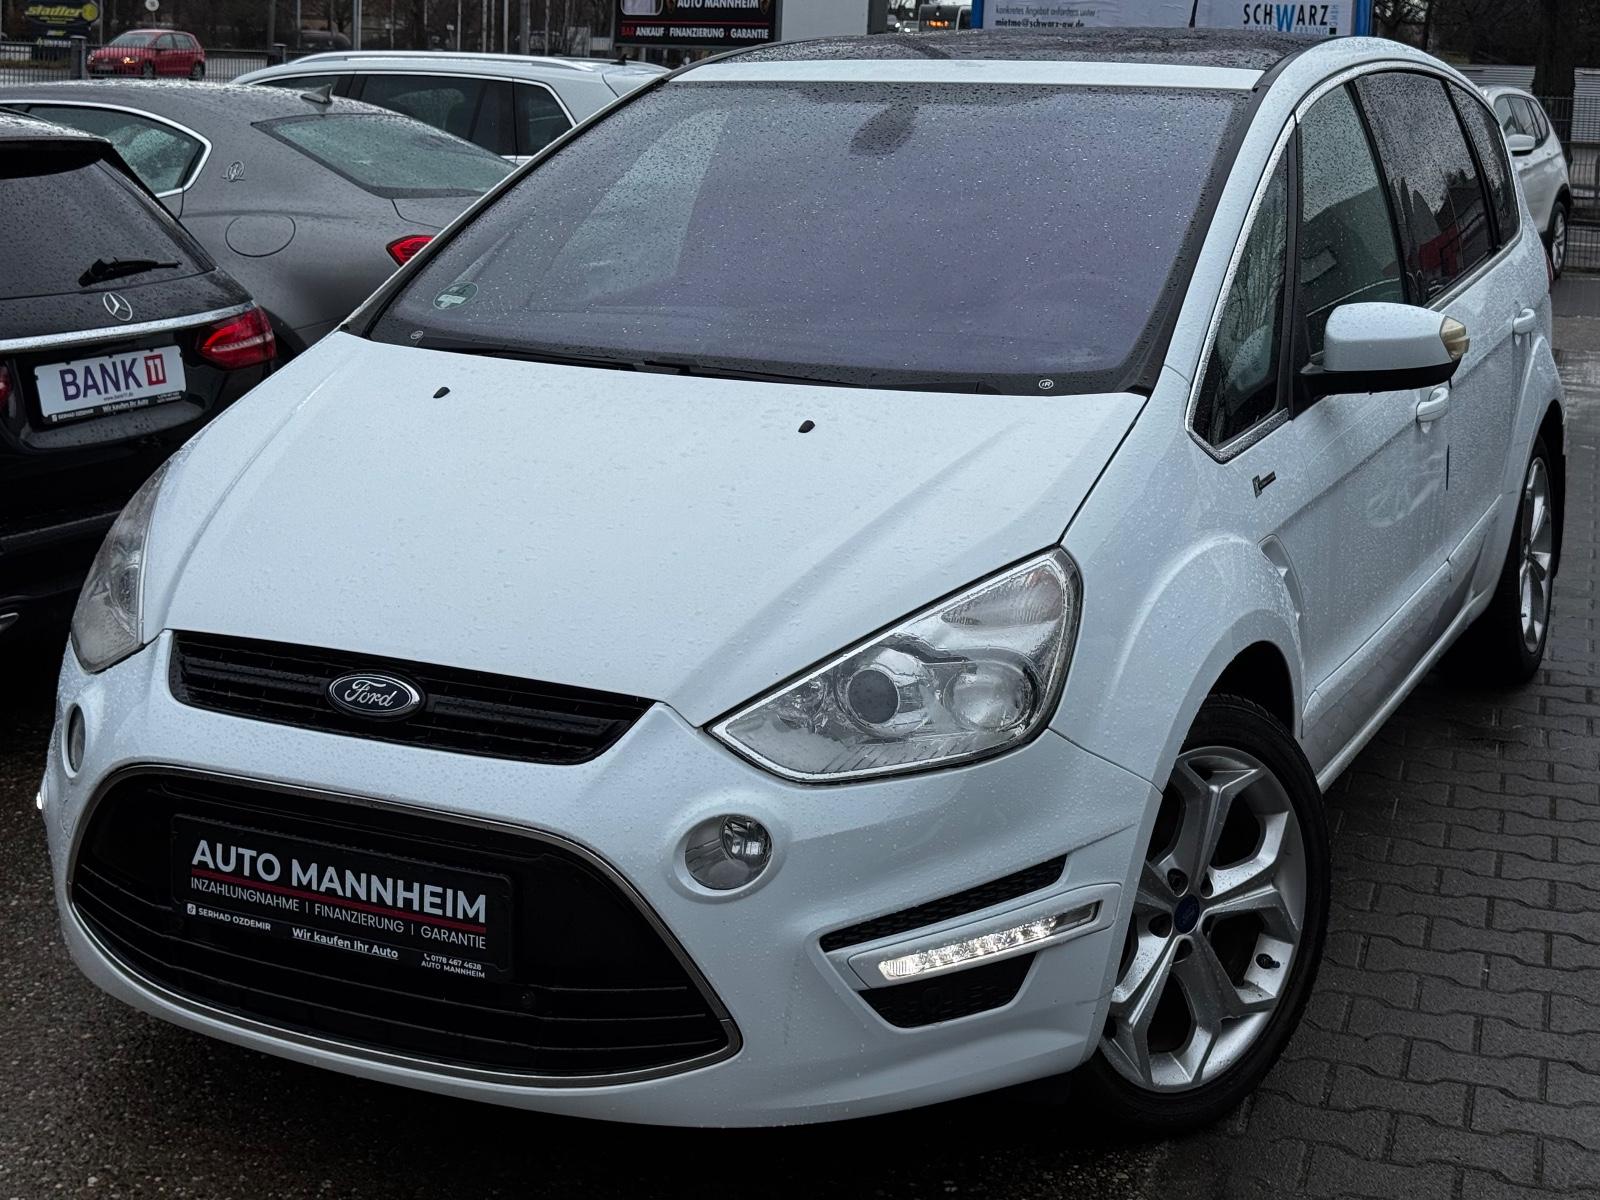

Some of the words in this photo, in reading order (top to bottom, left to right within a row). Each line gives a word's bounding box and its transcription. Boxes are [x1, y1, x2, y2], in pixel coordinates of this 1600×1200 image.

[677, 0, 702, 8] AUTO
[704, 0, 759, 8] MANNHEIM
[1243, 3, 1329, 32] SCHWARZ
[635, 26, 665, 37] ANKAUF
[669, 27, 725, 38] FINANZIERUNG
[730, 28, 769, 39] GARANTIE
[59, 357, 143, 402] BANK
[344, 679, 398, 707] Ford
[191, 839, 281, 882] AUTO
[291, 858, 487, 924] MANNHEIM
[190, 876, 301, 912] INZAHLUNGNAHME
[314, 903, 405, 933] FINANZIERUNG
[420, 925, 487, 950] GARANTIE
[198, 906, 231, 922] SERHAD
[232, 915, 272, 932] OZDEMIR
[292, 927, 311, 940] Wir
[313, 931, 351, 950] kaufen
[353, 940, 369, 953] Ihr
[371, 945, 399, 959] Auto
[421, 960, 442, 970] AUTO
[443, 965, 486, 979] MANNHEIM
